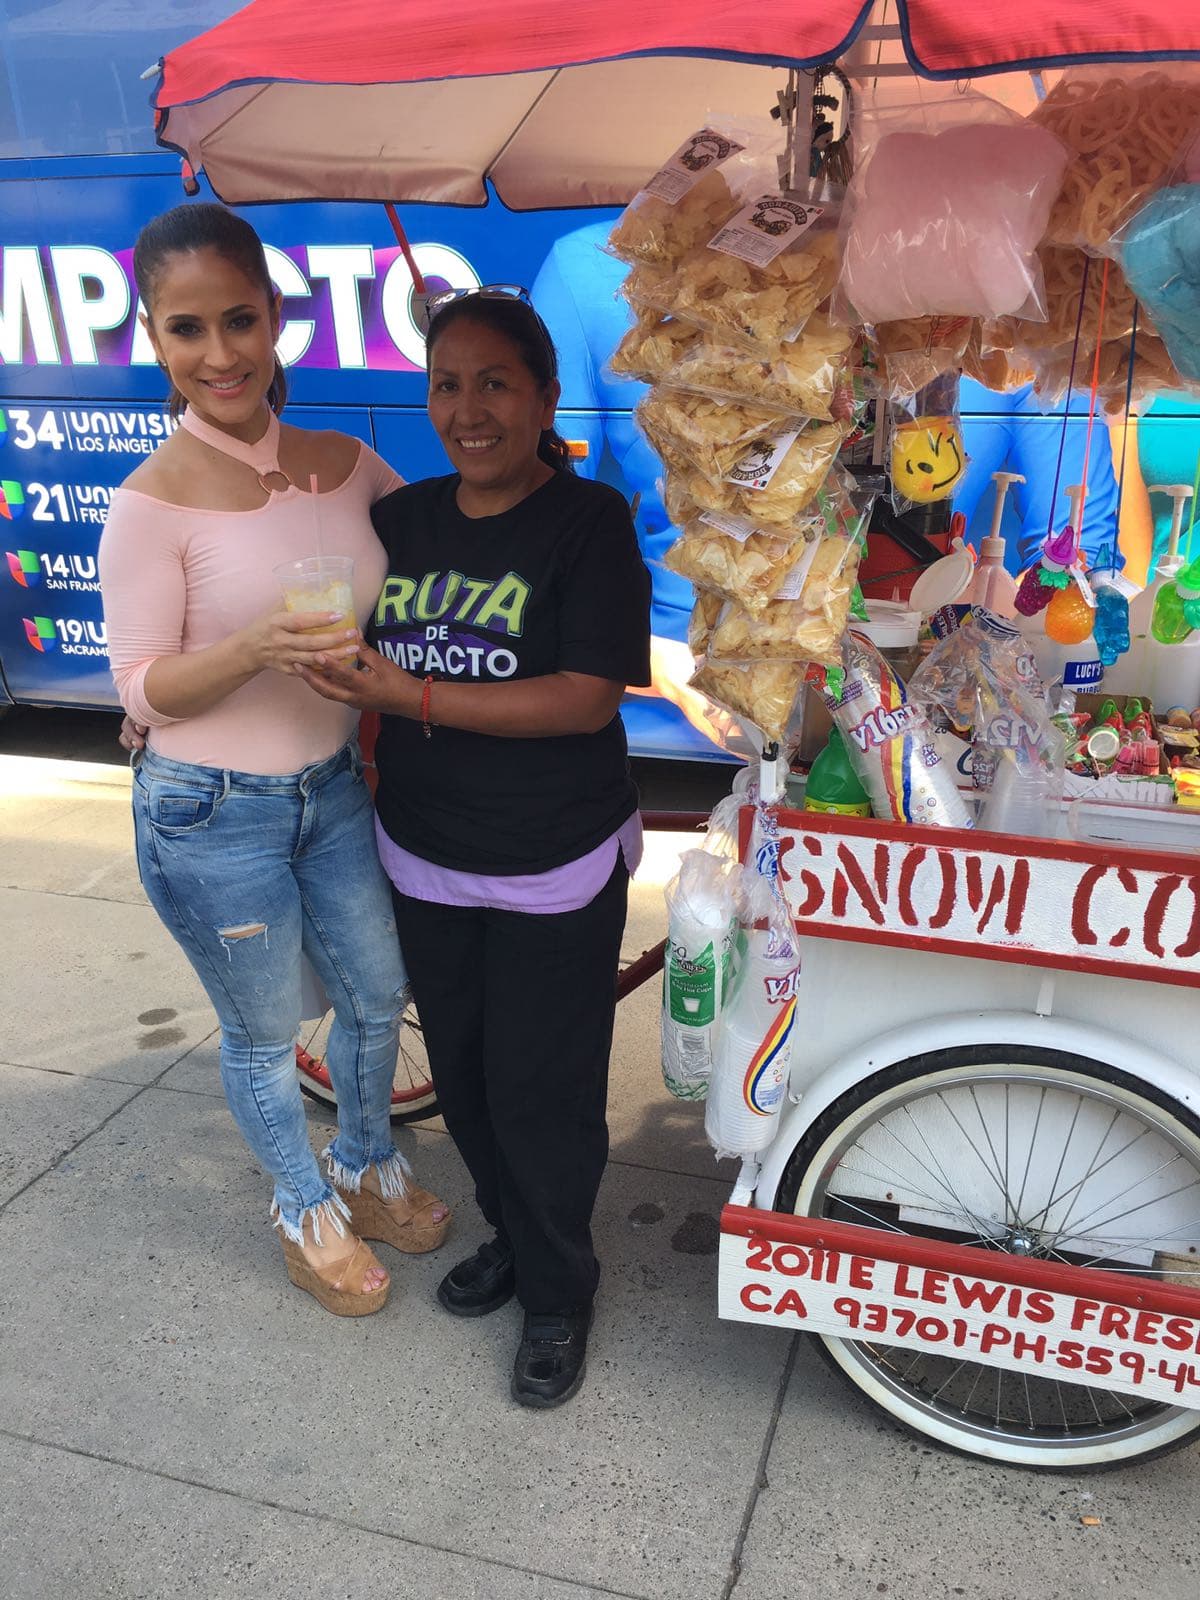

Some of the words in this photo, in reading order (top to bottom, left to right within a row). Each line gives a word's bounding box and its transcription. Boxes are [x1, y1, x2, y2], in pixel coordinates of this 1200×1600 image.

[8, 410, 65, 450] 34
[70, 411, 184, 437] UNIVISI
[76, 437, 105, 453] LOS
[27, 482, 70, 523] 21
[75, 486, 120, 505] UNI
[40, 553, 70, 578] 14
[73, 555, 97, 580] U
[46, 579, 68, 591] SAN
[376, 570, 533, 638] RUTA
[56, 619, 83, 643] 19
[87, 621, 108, 645] U
[425, 625, 449, 641] DE
[377, 639, 518, 678] IMPACTO
[778, 836, 1030, 935] SNOW
[740, 1283, 807, 1318] CA
[745, 1237, 840, 1284] 2011
[849, 1255, 875, 1290] E
[894, 1262, 1055, 1323] LEWIS
[1071, 1298, 1200, 1355] FRES
